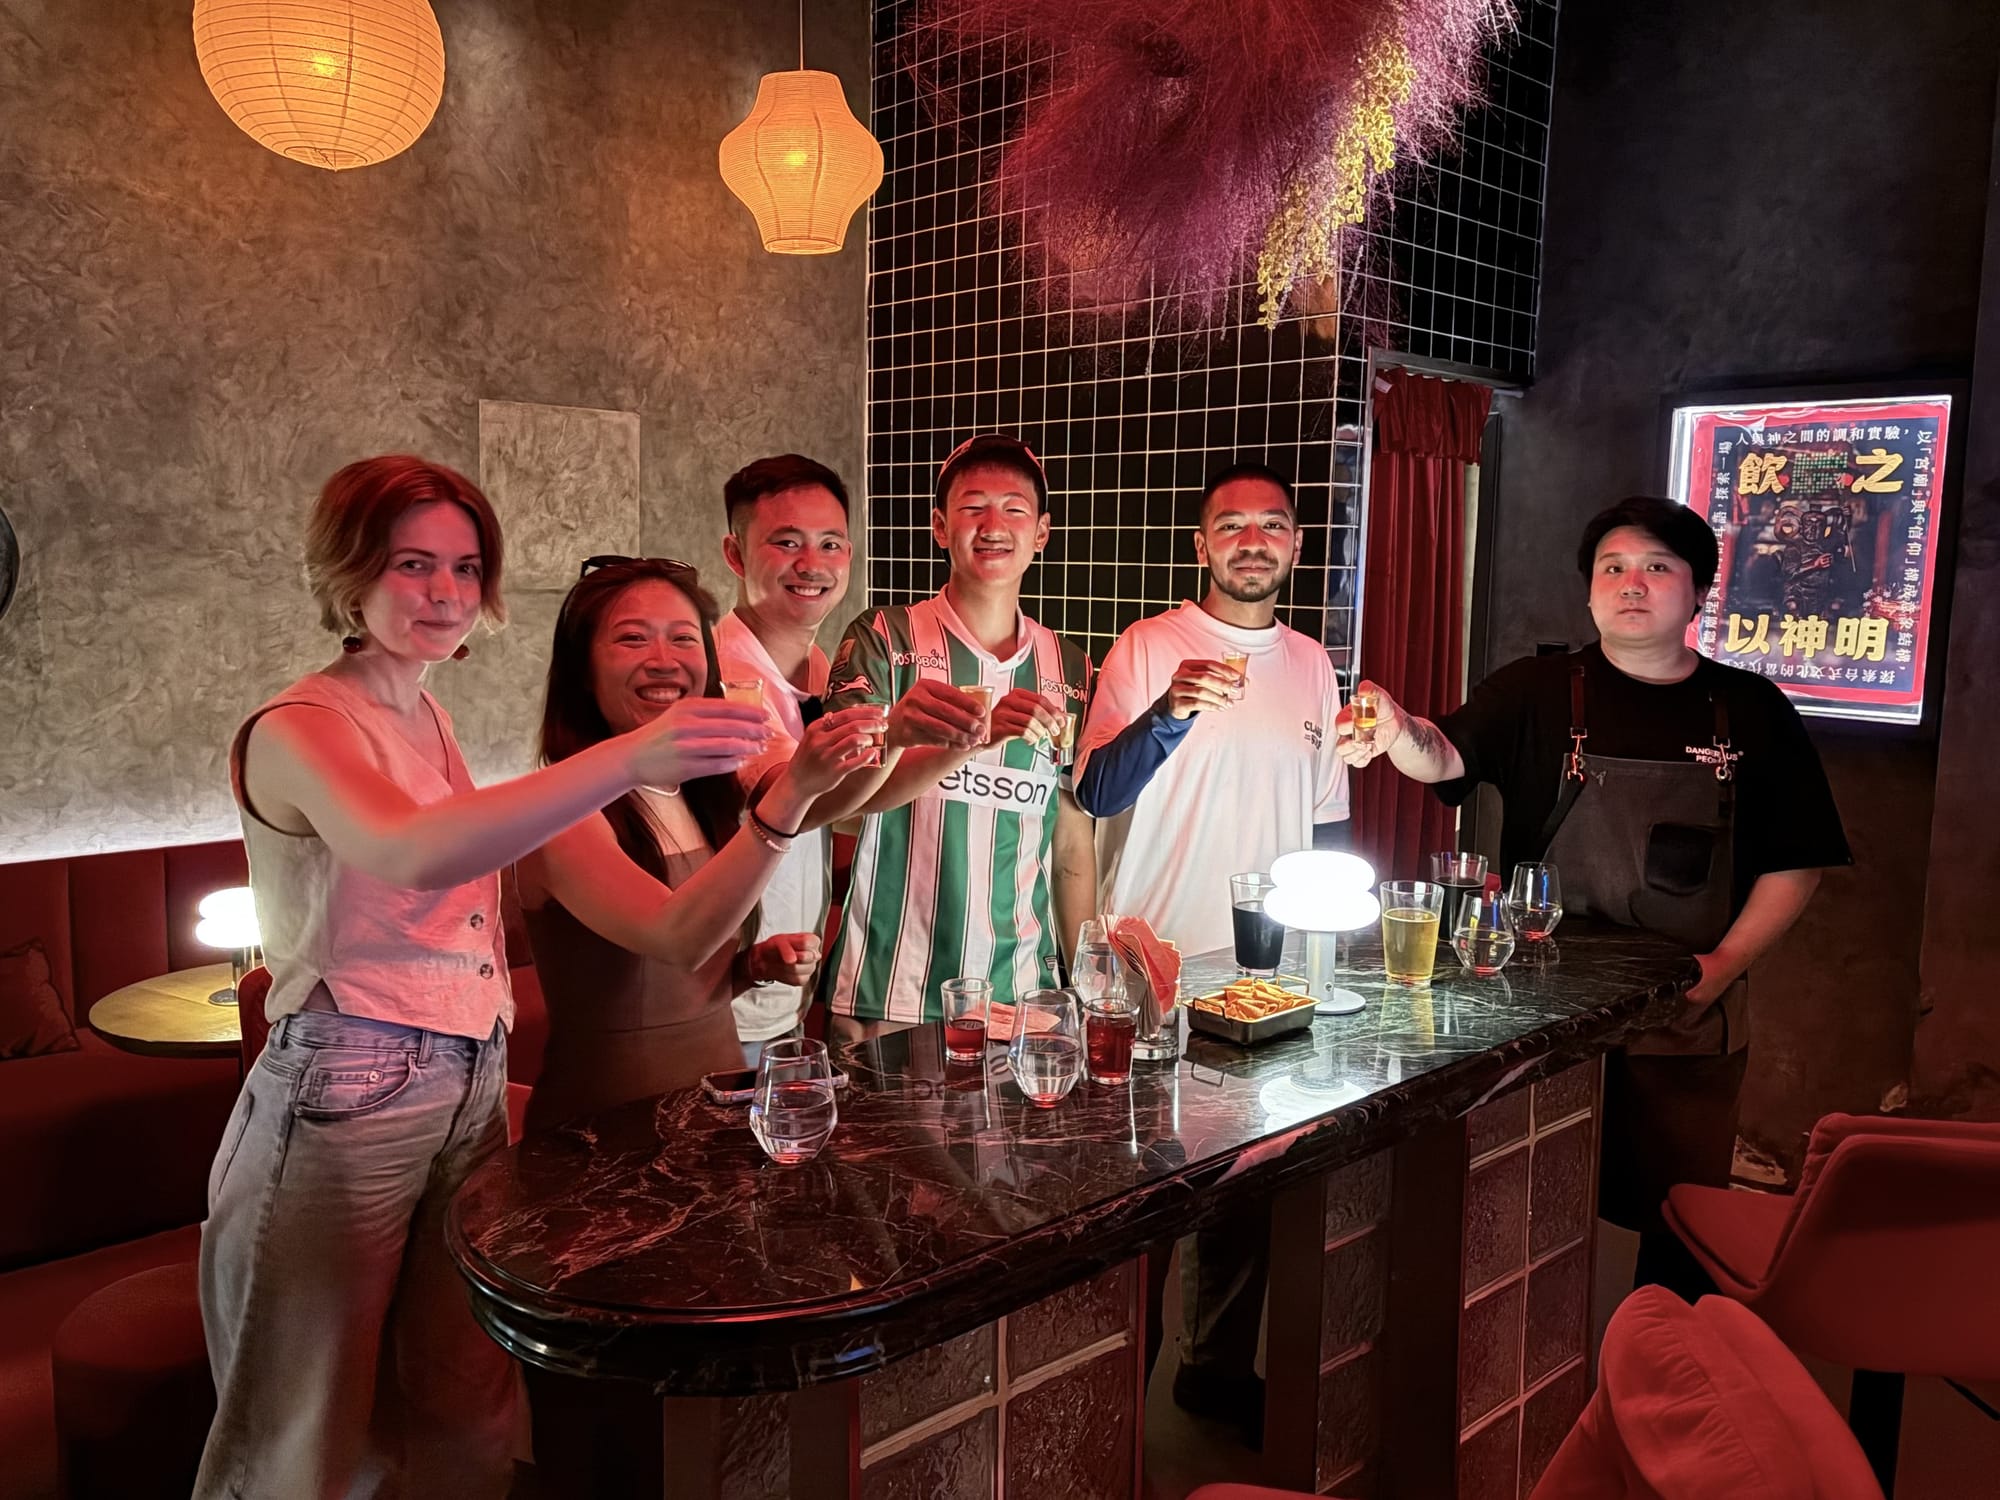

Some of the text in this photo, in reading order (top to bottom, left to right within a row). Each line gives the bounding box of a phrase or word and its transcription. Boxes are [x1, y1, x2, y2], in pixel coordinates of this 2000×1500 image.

[1737, 448, 1904, 495] 飲 之
[1724, 613, 1890, 662] 以神明
[1685, 746, 1739, 763] DANGERUS
[938, 764, 1047, 805] etsson
